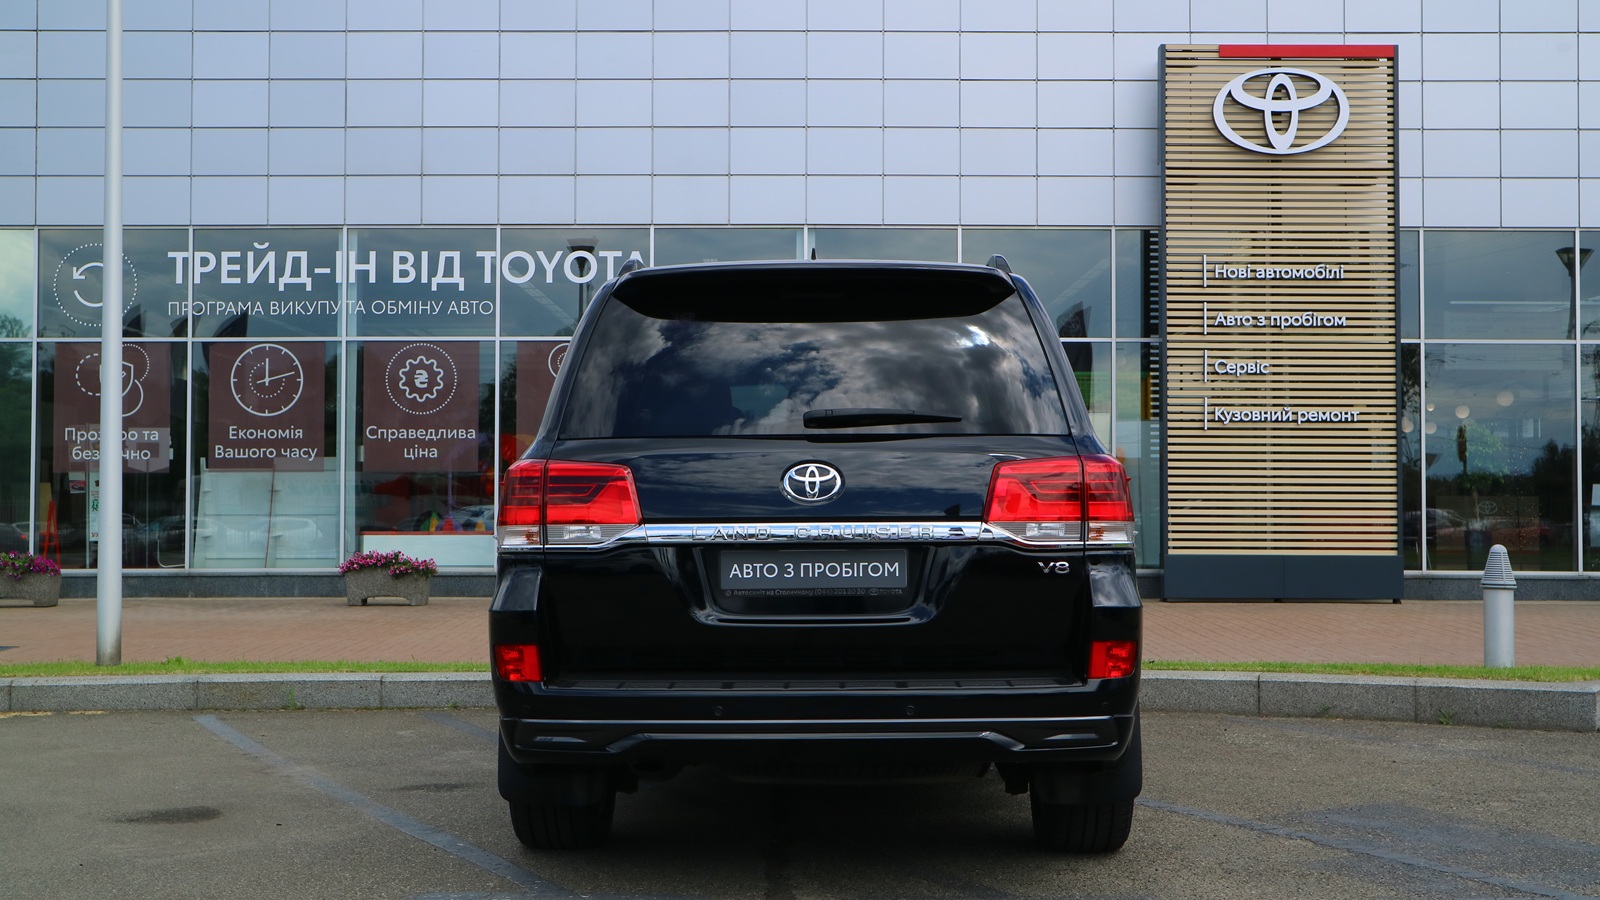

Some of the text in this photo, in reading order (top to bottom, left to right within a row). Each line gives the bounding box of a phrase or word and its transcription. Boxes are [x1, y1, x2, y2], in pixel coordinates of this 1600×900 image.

[167, 242, 376, 291] ТРЕЙД-ІН
[392, 250, 465, 291] ВІД
[1214, 264, 1345, 279] Нові автомобілі
[168, 300, 494, 316] ПРОГРАМА ВИКУПУ ТА ОБМІНУ АВТО
[1214, 312, 1347, 330] Авто з пробігом
[1214, 360, 1270, 377] Сервіс
[1214, 406, 1360, 425] Кузовний ремонт
[142, 430, 159, 441] та
[228, 426, 303, 440] Економія
[365, 425, 476, 442] Справедлива
[72, 446, 151, 460] безчно
[214, 445, 318, 462] Вашого часу
[403, 444, 438, 460] ціна
[690, 524, 935, 541] LAND CRUISER
[729, 563, 779, 579] АВТО
[799, 561, 900, 578] ПРОБІГОМ
[1037, 561, 1070, 574] V8
